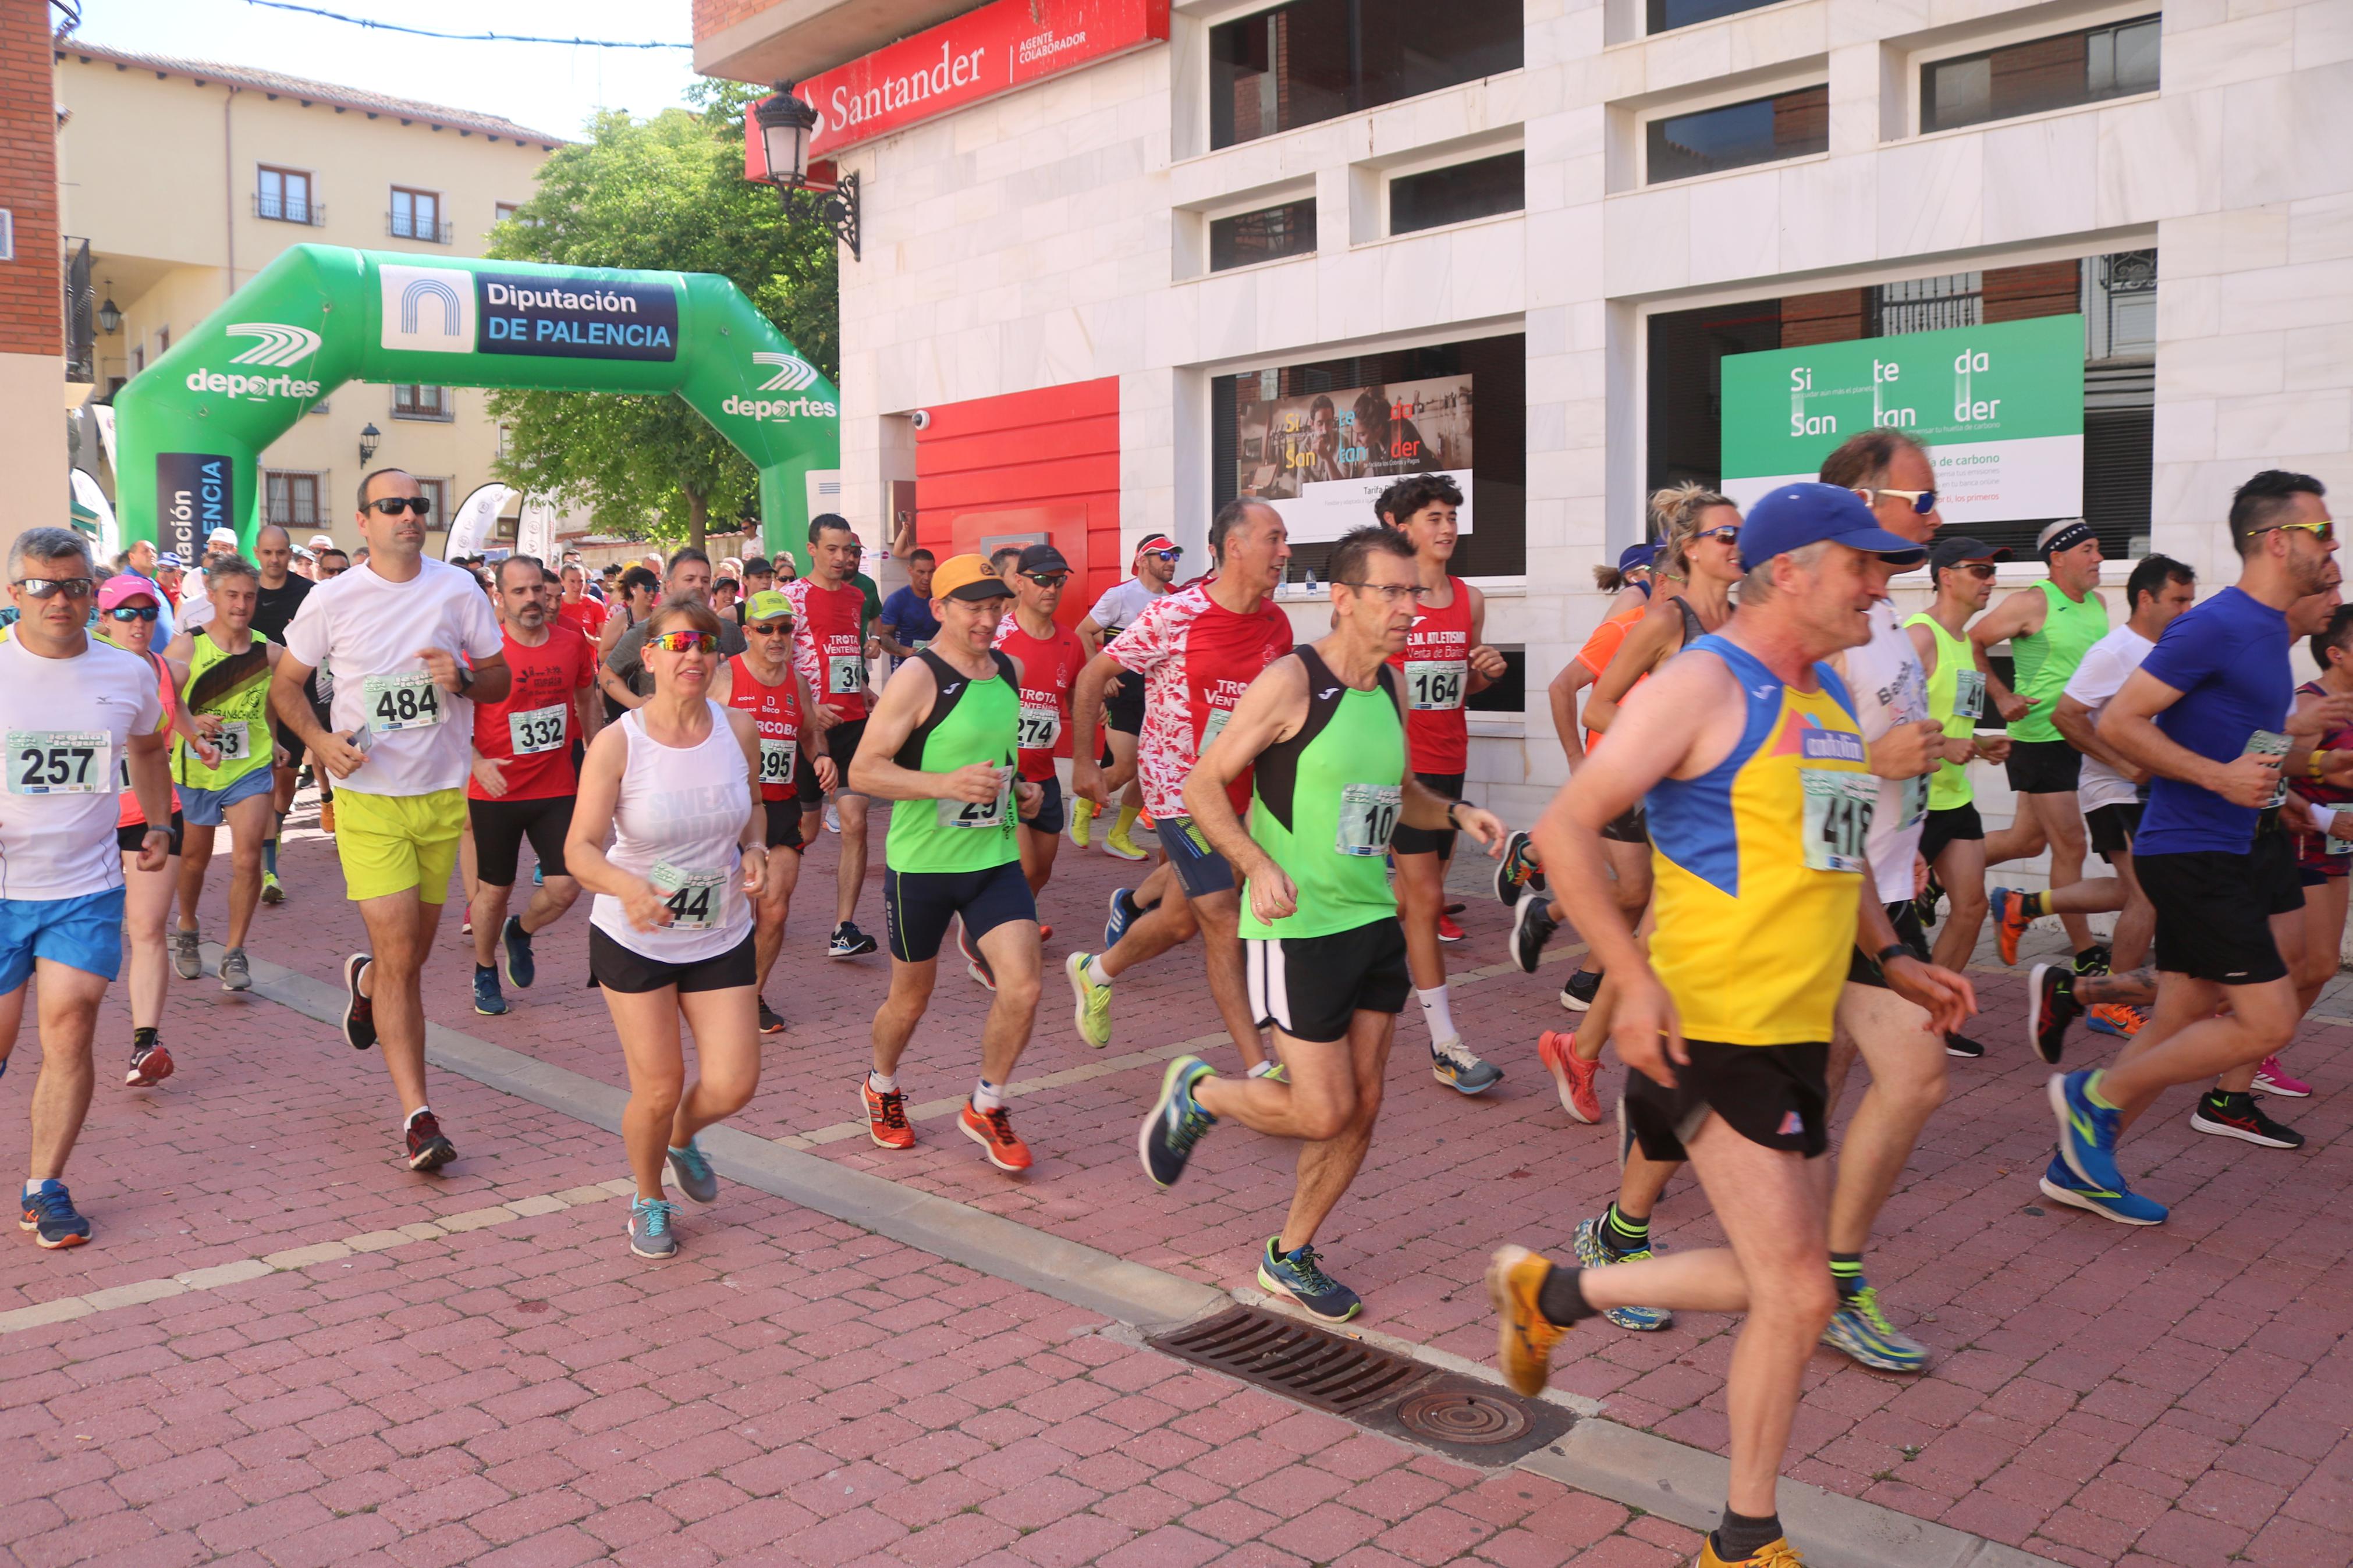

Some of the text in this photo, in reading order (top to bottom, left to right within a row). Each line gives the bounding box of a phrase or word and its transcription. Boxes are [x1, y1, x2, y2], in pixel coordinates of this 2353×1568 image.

[1018, 31, 1087, 65] COLABORADOR
[1019, 31, 1053, 53] AGENTE
[831, 40, 984, 131] Santander
[487, 282, 637, 313] Diputación
[488, 316, 670, 348] DE PALENCIA
[186, 368, 321, 399] deportes
[1791, 349, 1989, 392] Si te da
[722, 394, 837, 421] deportes
[1284, 400, 1413, 433] Si te da
[1791, 397, 2001, 436] San tan der
[1943, 424, 1963, 432] huella
[1285, 440, 1420, 469] San tan der
[1940, 457, 1953, 466] de
[1955, 454, 2000, 465] carbono
[1364, 485, 1383, 495] Tarifa
[1955, 494, 1965, 503] los
[1967, 493, 1999, 503] primeros
[201, 461, 222, 549] ENCIA
[170, 490, 194, 570] tación
[829, 634, 858, 645] TROTA
[1406, 647, 1431, 658] Venta
[1433, 646, 1443, 658] de
[1426, 631, 1466, 644] ATLETISMO
[1018, 688, 1057, 704] TROTA
[1216, 679, 1251, 695] TRO
[1415, 674, 1458, 703] 164
[376, 684, 438, 721] 484
[762, 705, 780, 714] Beco
[520, 717, 563, 747] 332
[756, 720, 798, 738] RCOBA
[1018, 717, 1052, 743] 274
[21, 748, 94, 785] 257
[1365, 805, 1393, 845] 10
[665, 887, 711, 921] 44
